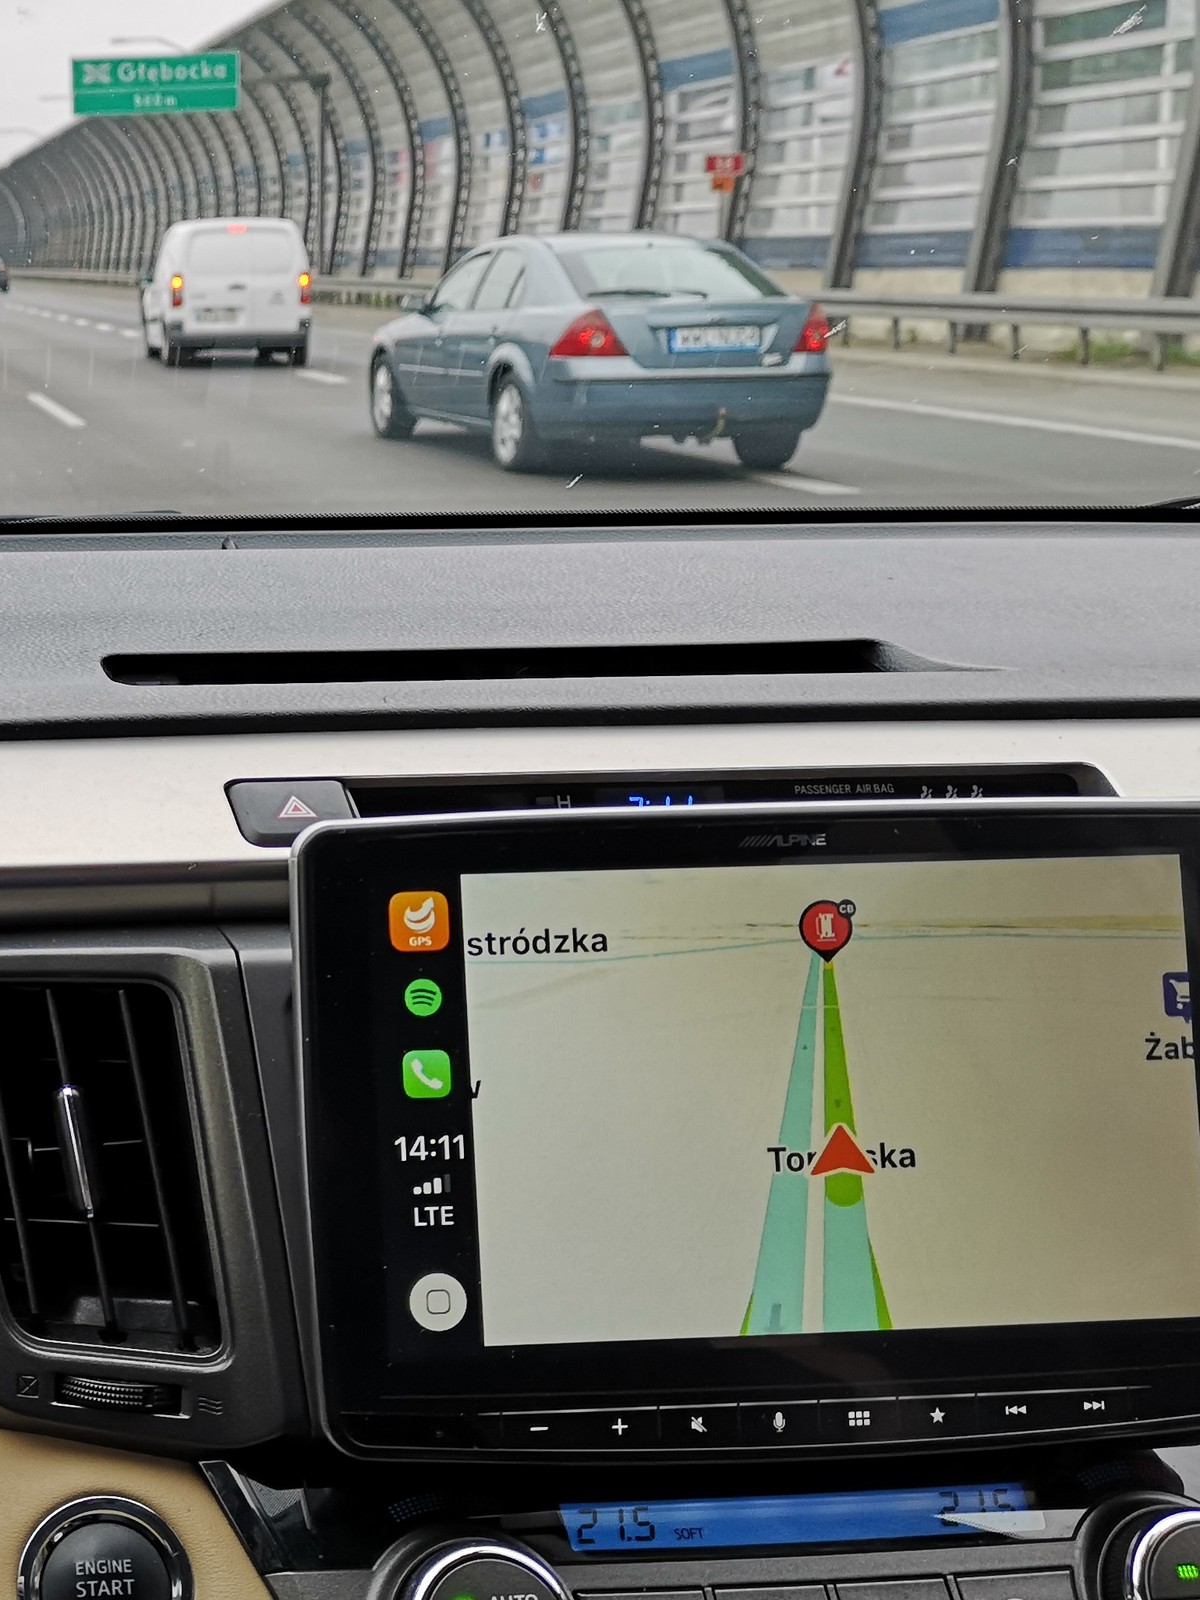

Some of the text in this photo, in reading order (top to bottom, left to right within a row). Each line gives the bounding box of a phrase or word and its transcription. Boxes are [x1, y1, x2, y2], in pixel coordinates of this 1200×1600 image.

[794, 785, 851, 795] PASSENGER
[839, 904, 854, 914] CB
[408, 936, 432, 947] GPS
[466, 928, 608, 957] stródzka
[1144, 1031, 1194, 1061] Żab
[394, 1134, 465, 1161] 14:11
[767, 1142, 917, 1173] Torska
[413, 1205, 455, 1227] LTE
[576, 1506, 704, 1544] 21.5 SOFT
[75, 1559, 133, 1576] ENGINE
[75, 1579, 135, 1598] START
